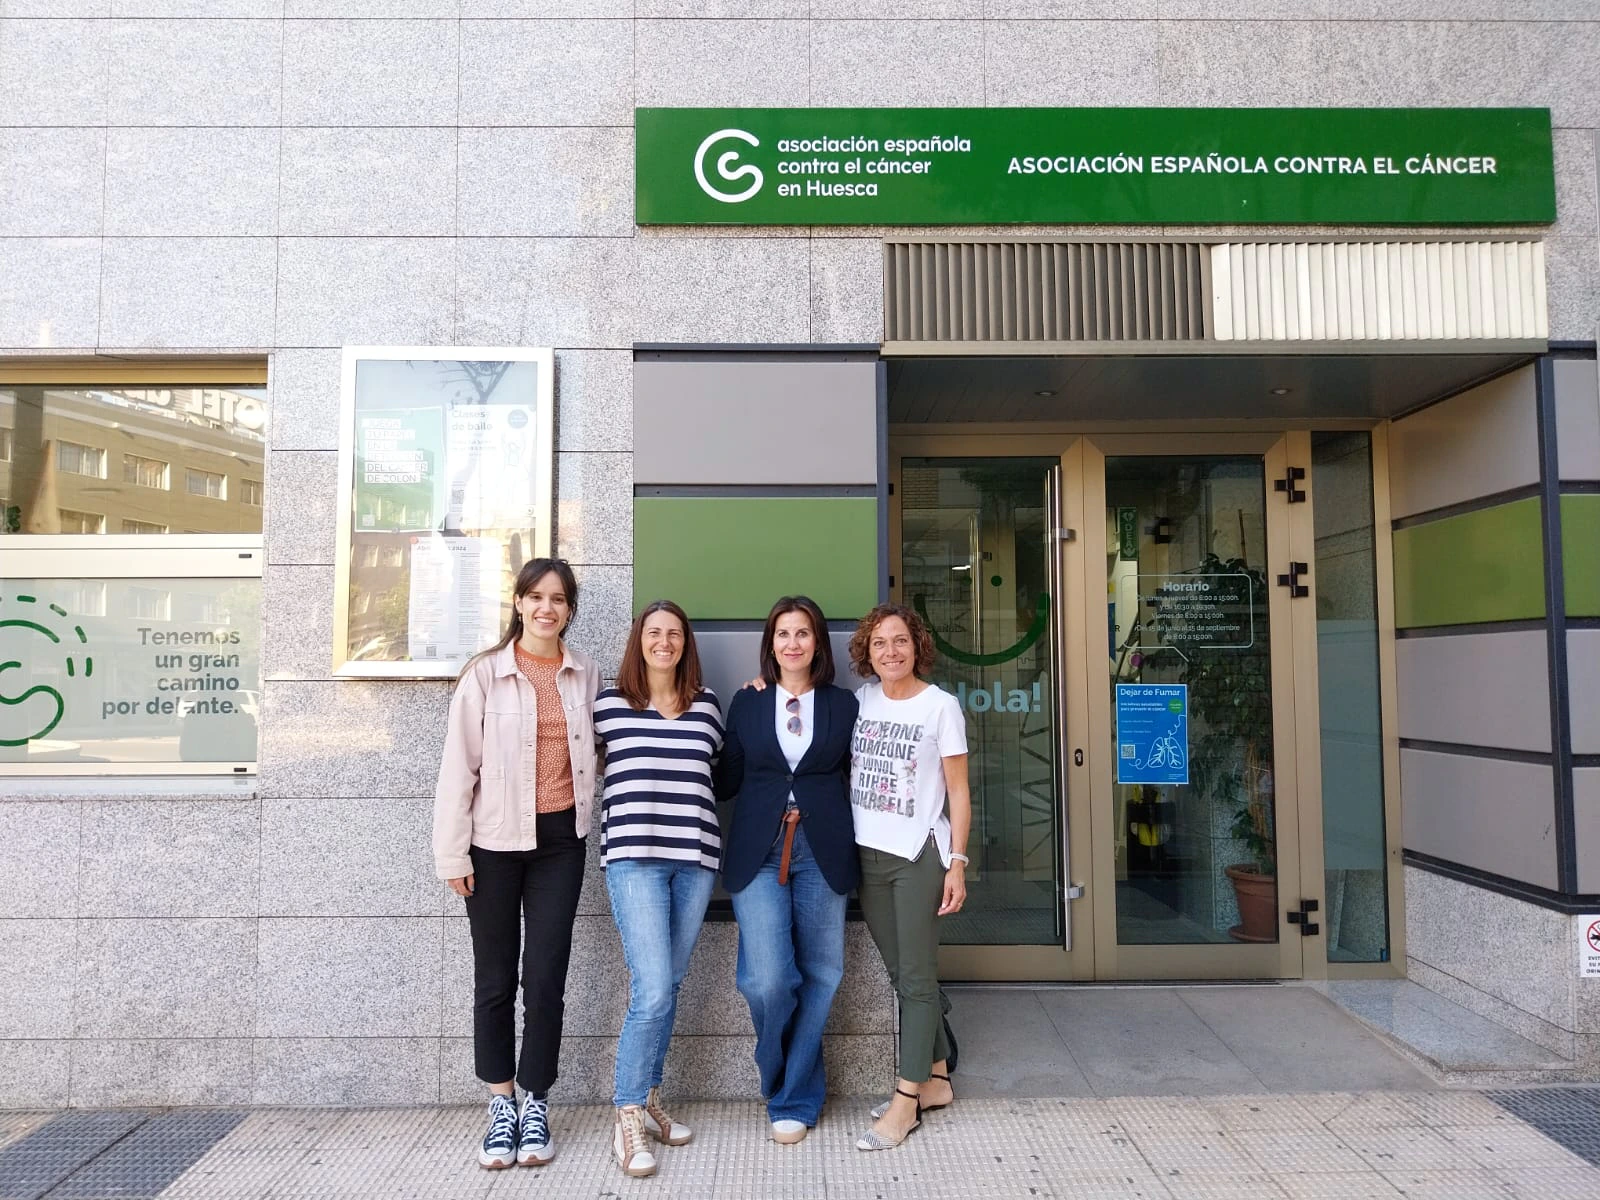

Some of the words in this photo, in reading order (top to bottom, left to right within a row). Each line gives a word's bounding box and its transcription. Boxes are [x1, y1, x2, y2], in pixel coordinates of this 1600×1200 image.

[777, 136, 879, 153] asociación
[884, 136, 971, 156] española
[777, 159, 840, 174] contra
[844, 157, 861, 174] el
[865, 158, 932, 174] cáncer
[1007, 152, 1143, 174] ASOCIACIÓN
[1151, 152, 1269, 174] ESPAÑOLA
[1274, 156, 1368, 174] CONTRA
[1373, 157, 1400, 174] EL
[1405, 153, 1497, 174] CÁNCER
[777, 183, 801, 196] en
[807, 180, 878, 197] Huesca
[1163, 581, 1210, 592] Horario
[137, 627, 241, 646] Tenemos
[1205, 624, 1241, 633] septiembre
[155, 654, 183, 668] un
[188, 654, 240, 673] gran
[157, 673, 240, 691] camino
[1120, 688, 1141, 697] Dejar
[1143, 688, 1154, 696] de
[1154, 688, 1181, 696] Fumar
[102, 701, 140, 720] por
